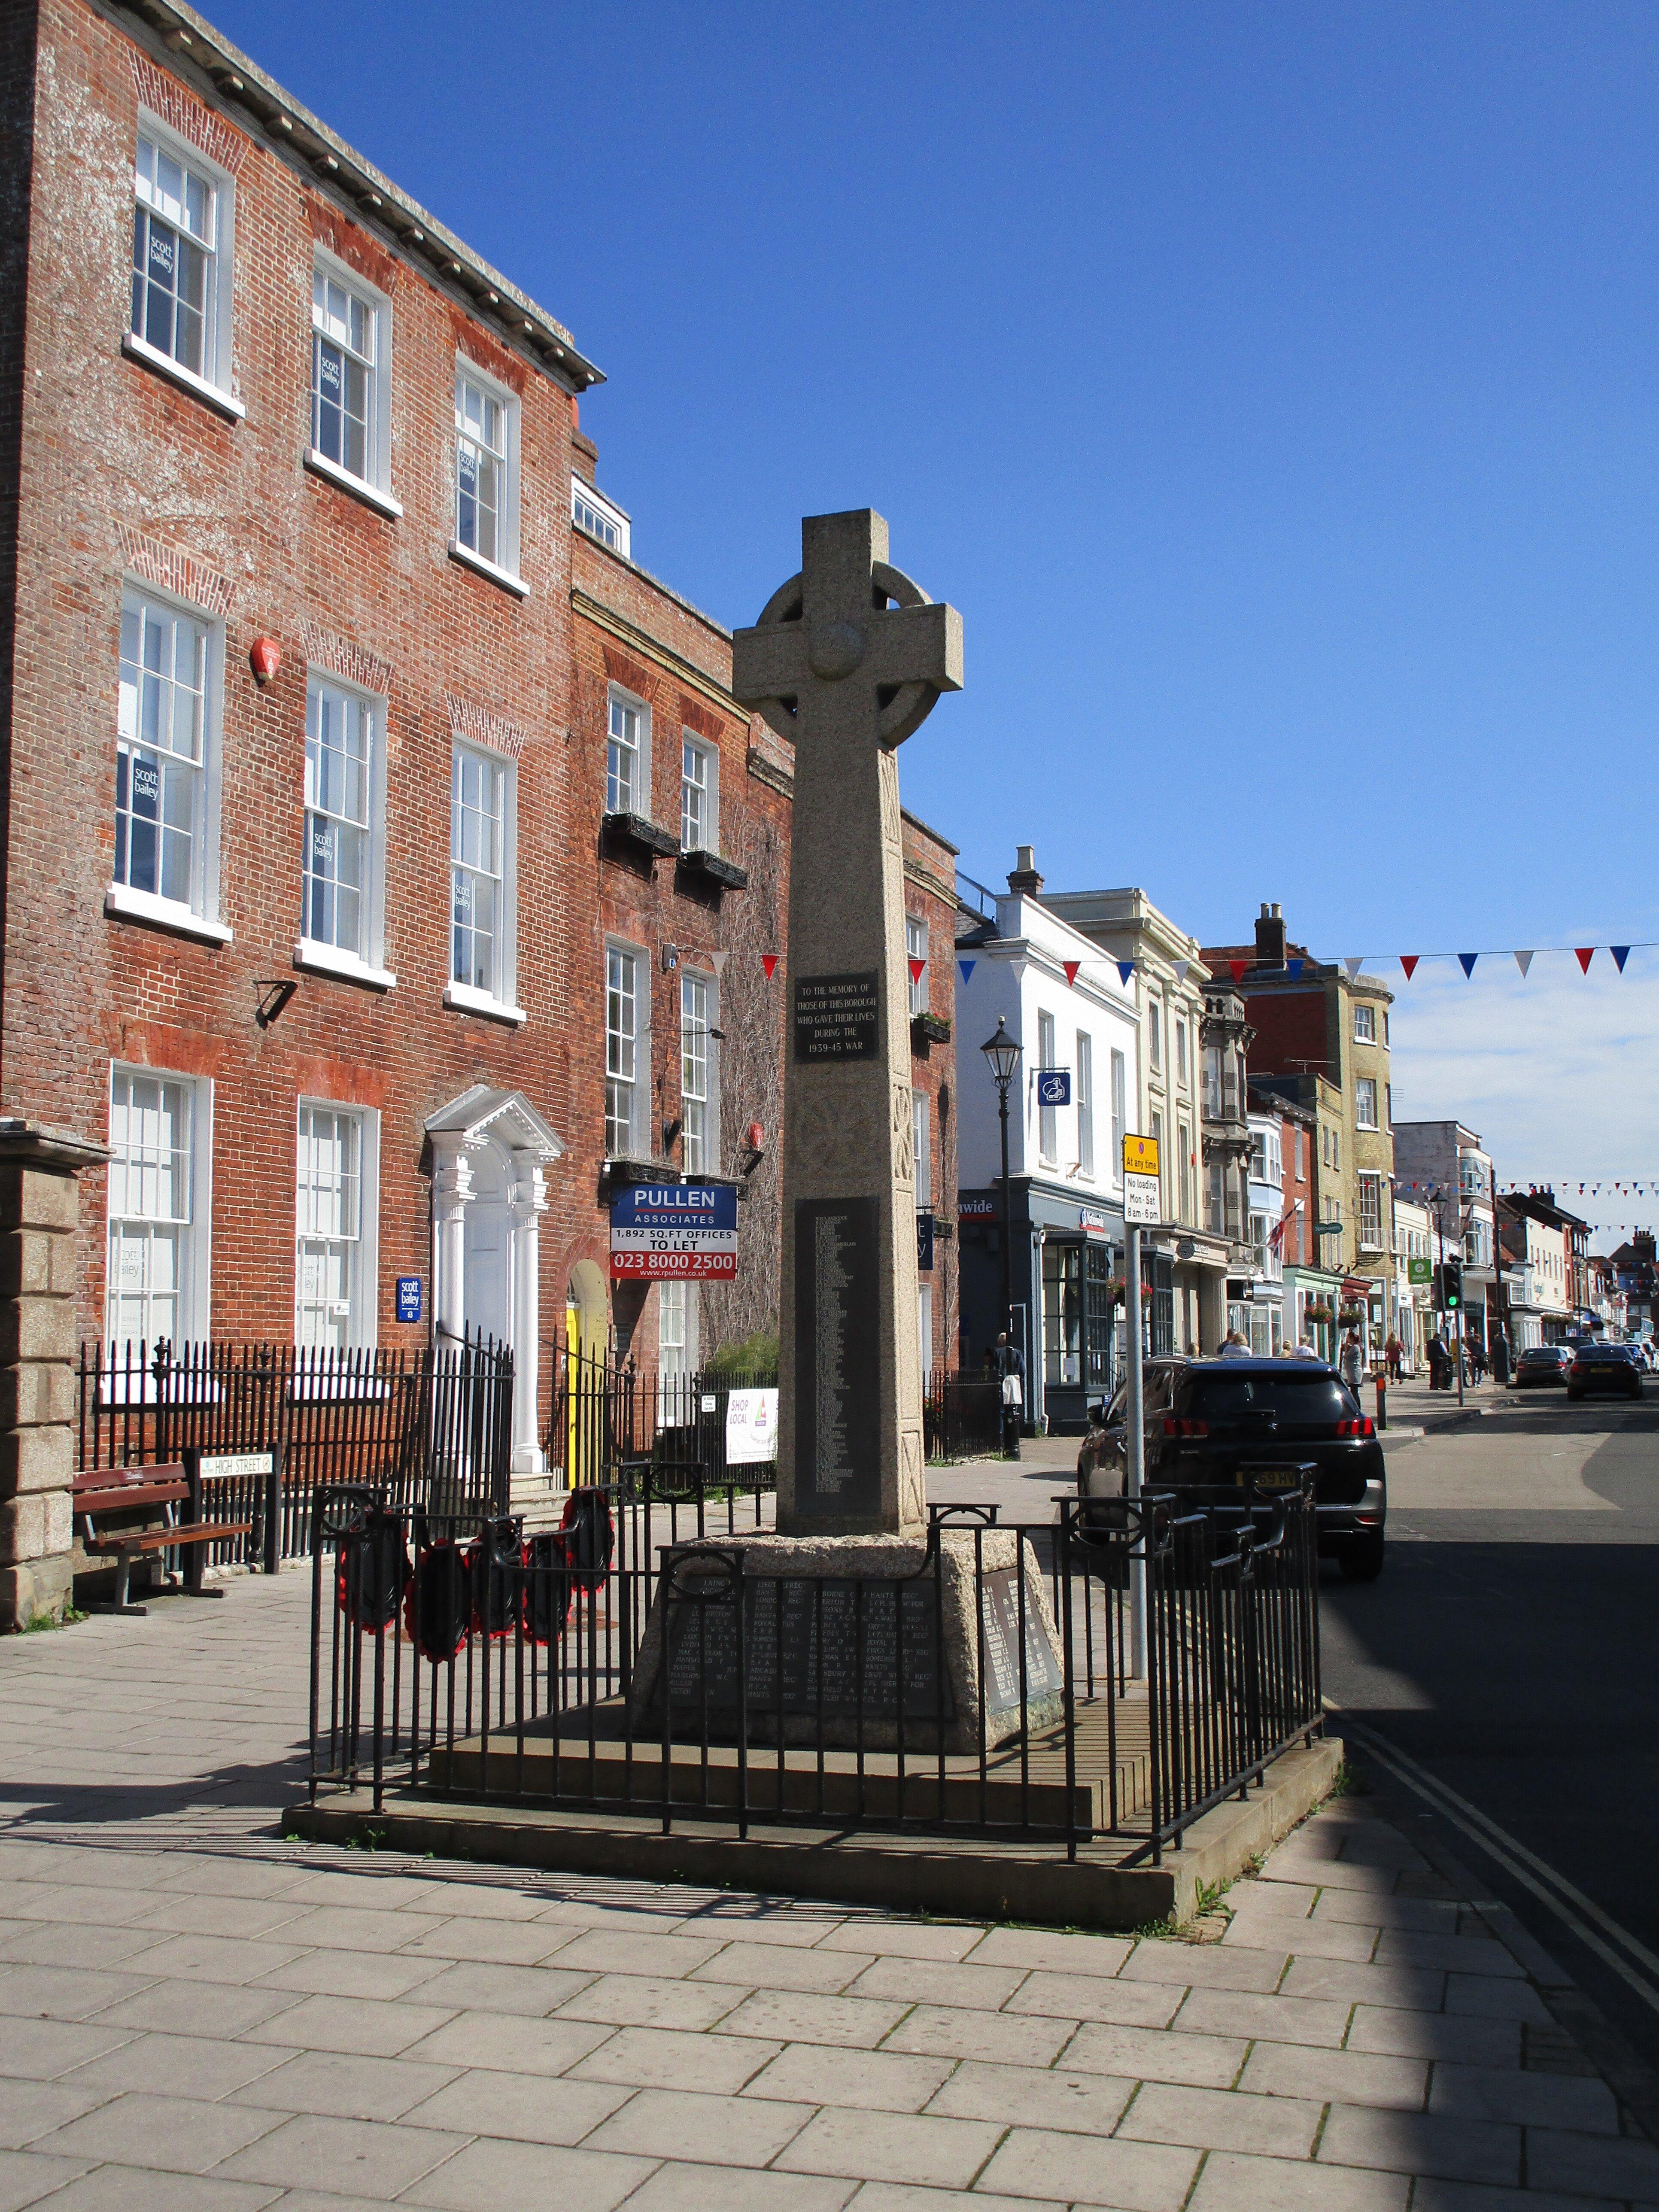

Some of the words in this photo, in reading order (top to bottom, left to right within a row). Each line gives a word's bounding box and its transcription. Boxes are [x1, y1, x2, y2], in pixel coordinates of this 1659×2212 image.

[135, 768, 158, 786] scott
[135, 778, 158, 801] bailey
[315, 833, 333, 848] scott
[314, 842, 333, 862] bailey
[456, 885, 470, 897] scott
[802, 988, 811, 996] TO
[814, 987, 826, 995] THE
[828, 985, 858, 994] MEMORY
[860, 984, 870, 993] OF
[797, 1001, 817, 1010] THOSE
[819, 1000, 827, 1009] OF
[829, 1000, 844, 1009] THIS
[845, 997, 876, 1007] BOROUGH
[797, 1016, 813, 1025] WHO
[814, 1015, 833, 1024] GAVE
[834, 1013, 853, 1022] THEIR
[855, 1012, 875, 1021] LIVES
[814, 1029, 840, 1038] DURING
[844, 1027, 857, 1036] THE
[809, 1042, 841, 1052] 1939-45
[846, 1042, 863, 1050] WAR
[1127, 1156, 1133, 1167] At
[1135, 1159, 1143, 1170] any
[1145, 1160, 1157, 1170] time
[1128, 1178, 1135, 1188] No
[1137, 1179, 1156, 1192] loading
[635, 1190, 714, 1207] PULLEN
[1130, 1194, 1142, 1203] Mon
[1146, 1195, 1155, 1206] Sat
[634, 1215, 714, 1224] ASSOCIATES
[616, 1230, 645, 1239] 1,892
[650, 1230, 682, 1239] SQ.FT
[687, 1231, 732, 1239] OFFICES
[650, 1240, 668, 1250] TO
[674, 1240, 698, 1251] LET
[614, 1254, 644, 1268] 023
[648, 1254, 689, 1269] 8000
[693, 1255, 732, 1269] 2500
[640, 1270, 707, 1278] www.rpullen.co.uk
[401, 1281, 419, 1292] scott
[401, 1292, 419, 1307] bailey
[731, 1400, 748, 1411] SHOP
[730, 1414, 747, 1424] LOCAL
[215, 1460, 232, 1474] HIGH
[236, 1458, 261, 1472] STREET
